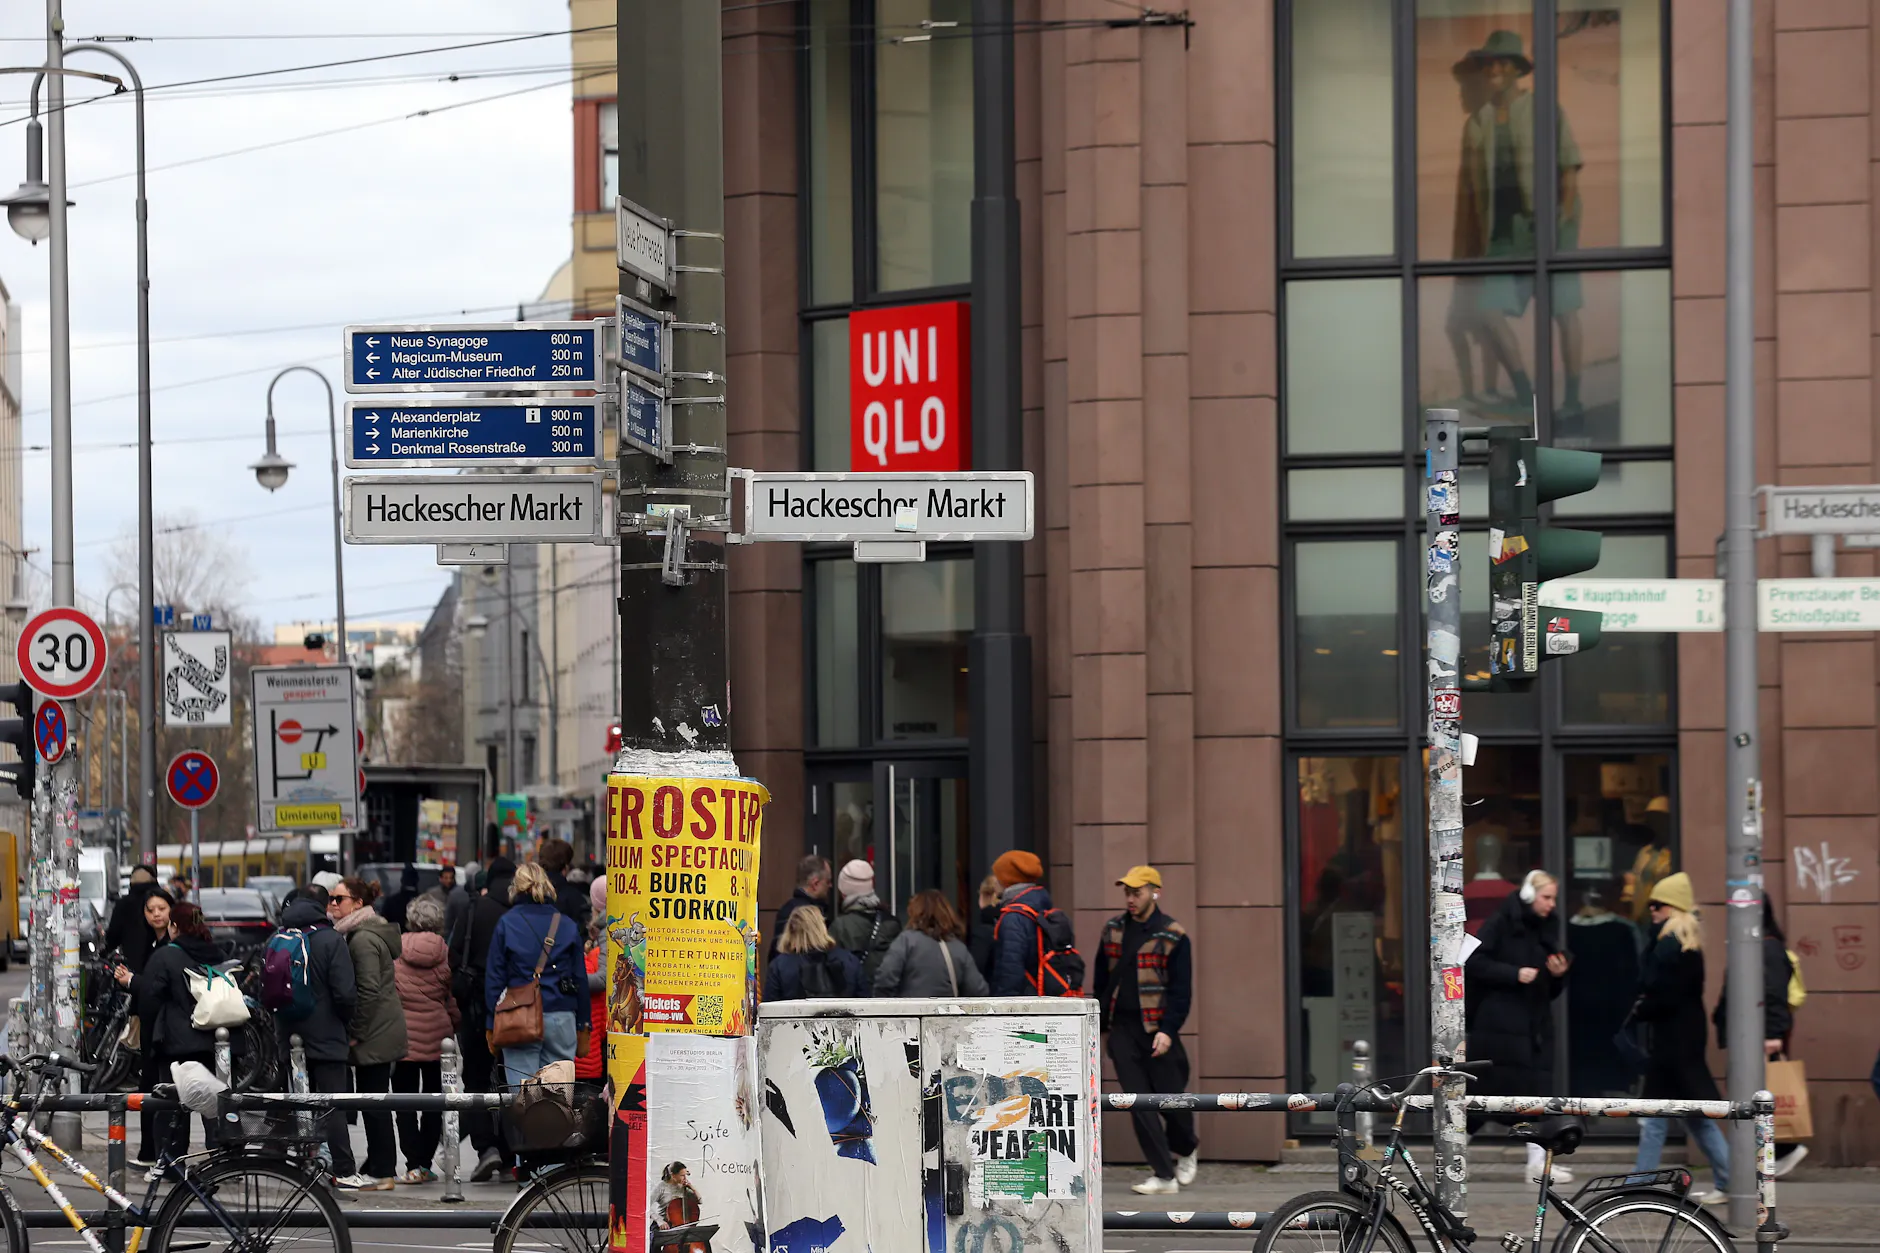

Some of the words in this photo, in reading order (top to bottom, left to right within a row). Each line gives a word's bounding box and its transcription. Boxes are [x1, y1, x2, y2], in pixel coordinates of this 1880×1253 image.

[391, 335, 424, 348] Neue
[427, 335, 489, 351] Synagoge
[551, 333, 571, 346] 600
[572, 336, 583, 345] m
[391, 351, 503, 366] Magicum-Museum
[551, 349, 571, 361] 300
[572, 352, 583, 361] m
[862, 326, 938, 387] UNI
[392, 366, 421, 379] Alter
[423, 365, 483, 379] Jüdischer
[485, 364, 536, 378] Friedhof
[551, 364, 571, 377] 250
[572, 367, 583, 377] m
[391, 410, 481, 426] Alexanderplatz
[551, 410, 571, 422] 900
[572, 412, 583, 421] m
[391, 425, 469, 439] Marienkirche
[551, 425, 571, 438] 500
[572, 428, 583, 438] m
[863, 396, 946, 466] QLO
[391, 441, 446, 456] Denkmal
[448, 440, 526, 455] Rosenstraße
[551, 441, 571, 454] 300
[572, 444, 583, 453] m
[366, 493, 505, 523] Hackescher
[510, 492, 583, 522] Markt
[768, 488, 918, 518] Hackescher
[927, 488, 1006, 518] Markt
[468, 547, 477, 559] 4
[1583, 587, 1667, 605] Hauptbahnhof
[1769, 587, 1855, 602] Prenzlauer
[1770, 608, 1861, 624] Schloßplatz
[36, 633, 88, 673] 30
[266, 674, 341, 689] Weinmeisterstr.
[283, 688, 327, 702] gesperrt
[308, 755, 319, 769] U
[279, 807, 338, 824] Umleitung
[652, 785, 761, 845] OSTER
[650, 872, 707, 895] BURG
[649, 897, 738, 922] STORKOW
[648, 927, 705, 935] HISTORISCHER
[644, 996, 681, 1011] Tickets
[649, 1011, 684, 1021] Online-VVK
[1028, 1093, 1079, 1127] ART
[1518, 1099, 1541, 1113] JEDER
[686, 1120, 730, 1142] Suite
